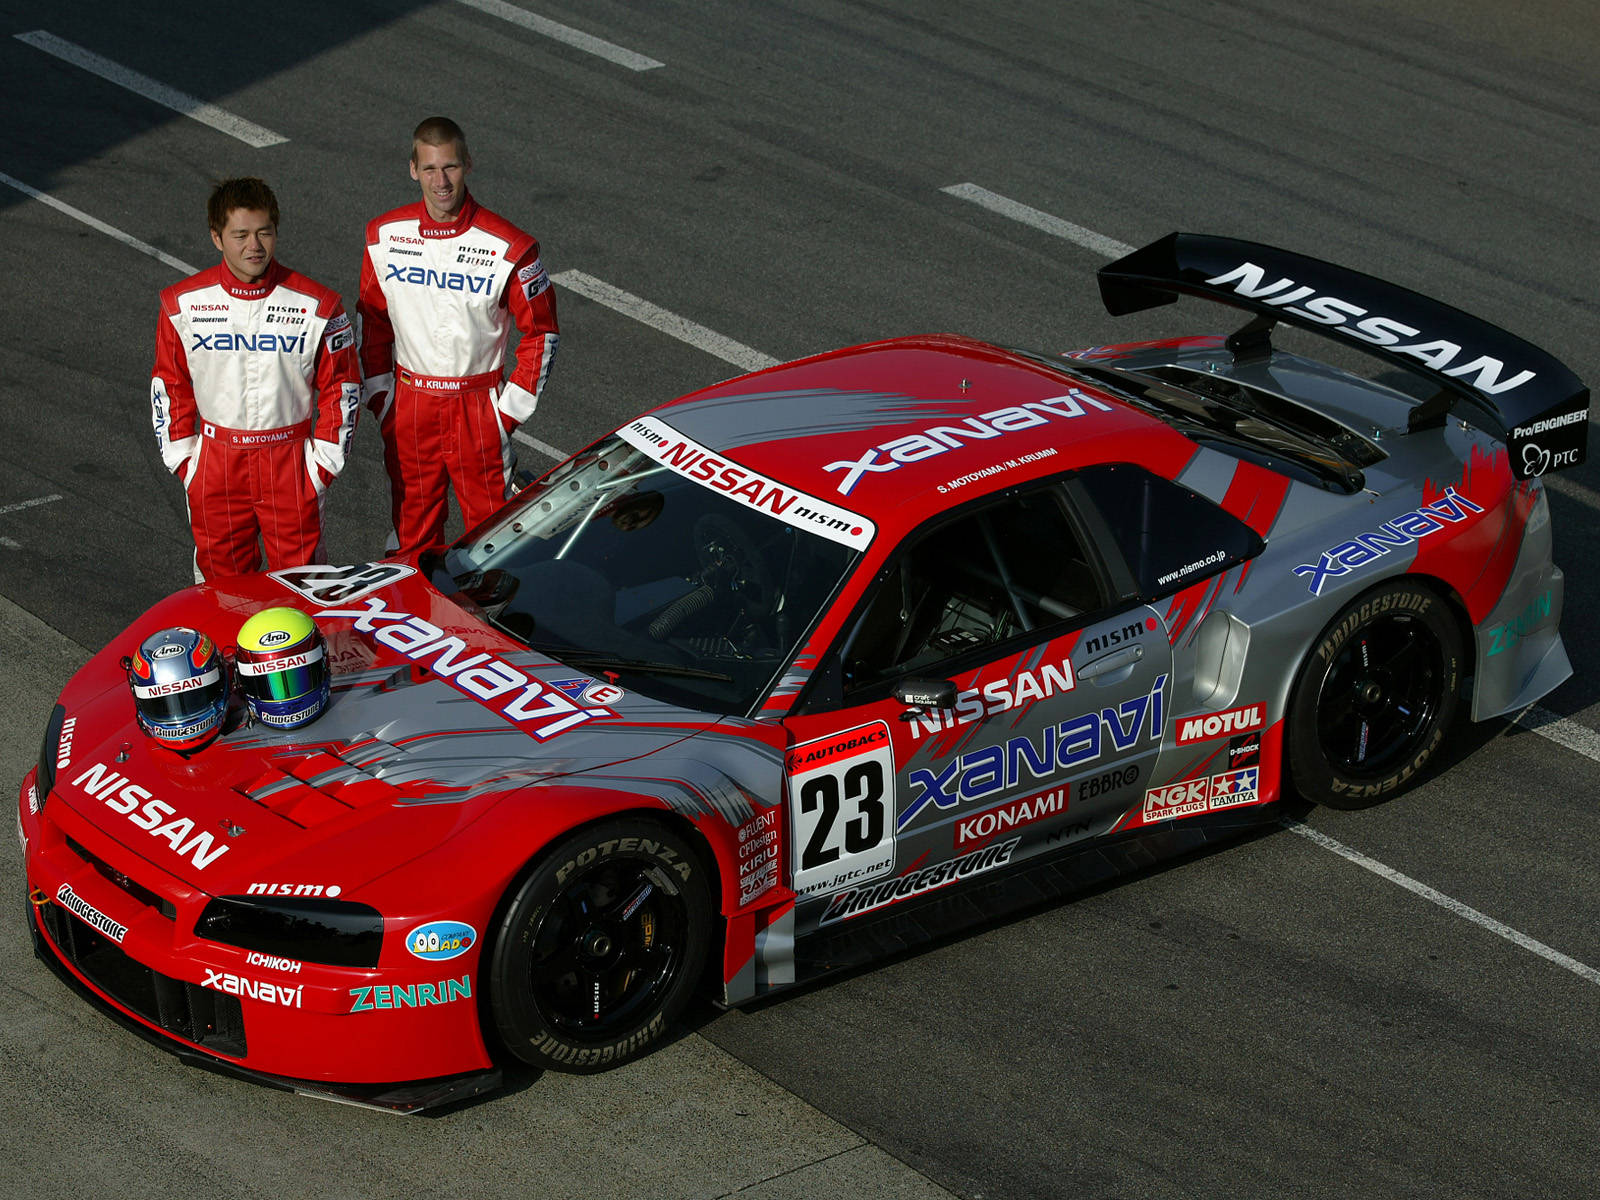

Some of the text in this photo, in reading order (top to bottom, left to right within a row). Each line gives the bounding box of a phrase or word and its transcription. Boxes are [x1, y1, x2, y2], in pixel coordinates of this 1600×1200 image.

[389, 235, 424, 245] NISSAN
[1204, 262, 1536, 395] NISSAN
[659, 441, 799, 516] NISSAN
[1157, 550, 1226, 586] www.nismo.co.jp
[158, 645, 181, 656] Arai
[264, 632, 287, 643] Arai
[252, 655, 307, 675] NISSAN
[148, 677, 203, 697] NISSAN
[908, 658, 1075, 739] NISSAN
[155, 715, 214, 738] BRIDGESTONE
[262, 702, 320, 724] BRIDGESTONE
[1181, 706, 1261, 741] MOTUL
[805, 729, 888, 764] AUTOBACS
[1230, 743, 1260, 756] G-SHOCK
[1146, 780, 1207, 811] NGK
[1146, 801, 1205, 820] SPARK PLUGS
[1211, 791, 1256, 807] TAMIYA
[71, 762, 230, 870] NISSAN
[800, 760, 884, 872] 23
[959, 789, 1064, 843] KONAMI
[555, 837, 693, 886] POTENZA
[740, 844, 778, 876] KIRIU
[795, 859, 892, 897] www.jgtc.net
[820, 837, 1021, 926] BRIDGESTONE
[57, 884, 127, 942] BRIDGESTONE
[246, 951, 301, 974] ICHIKOH
[349, 975, 472, 1013] ZENRIN
